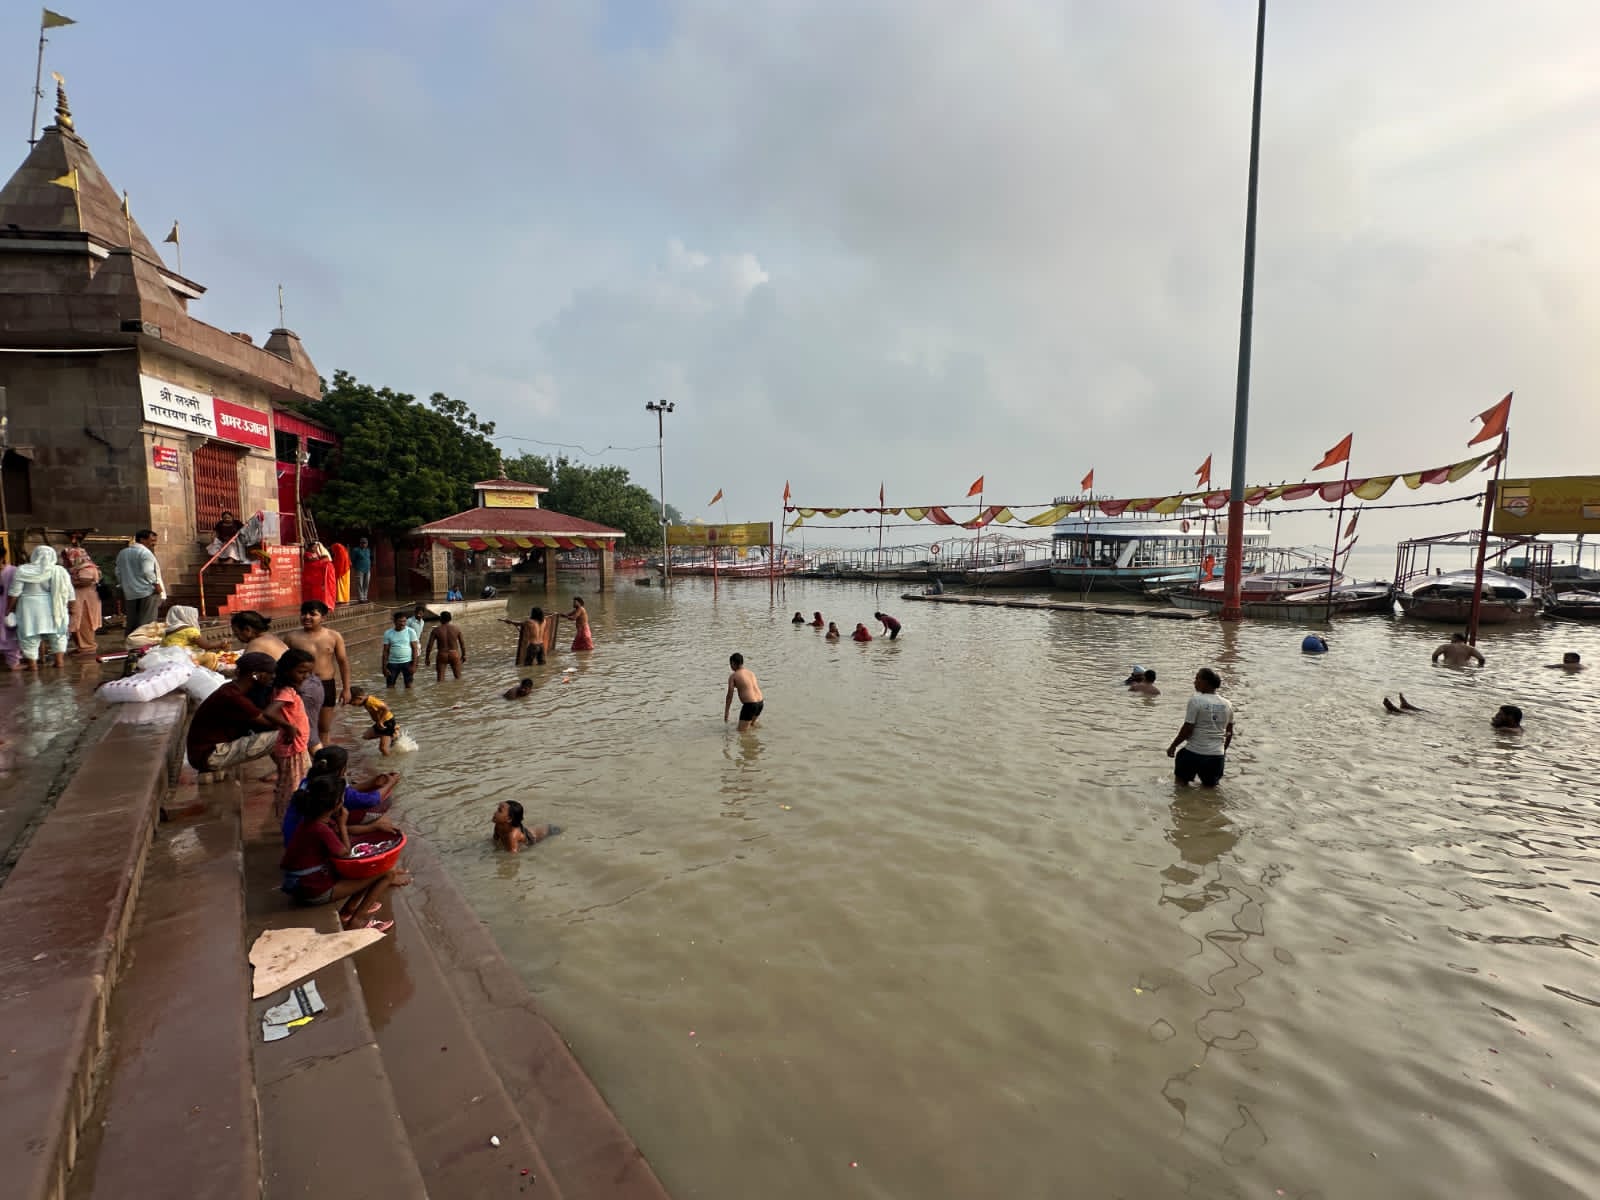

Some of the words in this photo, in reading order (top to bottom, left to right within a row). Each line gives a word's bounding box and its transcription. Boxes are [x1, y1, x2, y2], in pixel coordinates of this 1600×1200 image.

[160, 386, 171, 403] श्री
[174, 394, 200, 410] लक्ष्मी
[149, 404, 187, 422] नारायण
[190, 413, 213, 430] मंदिर
[219, 412, 242, 430] अमर
[242, 420, 268, 437] उजाला
